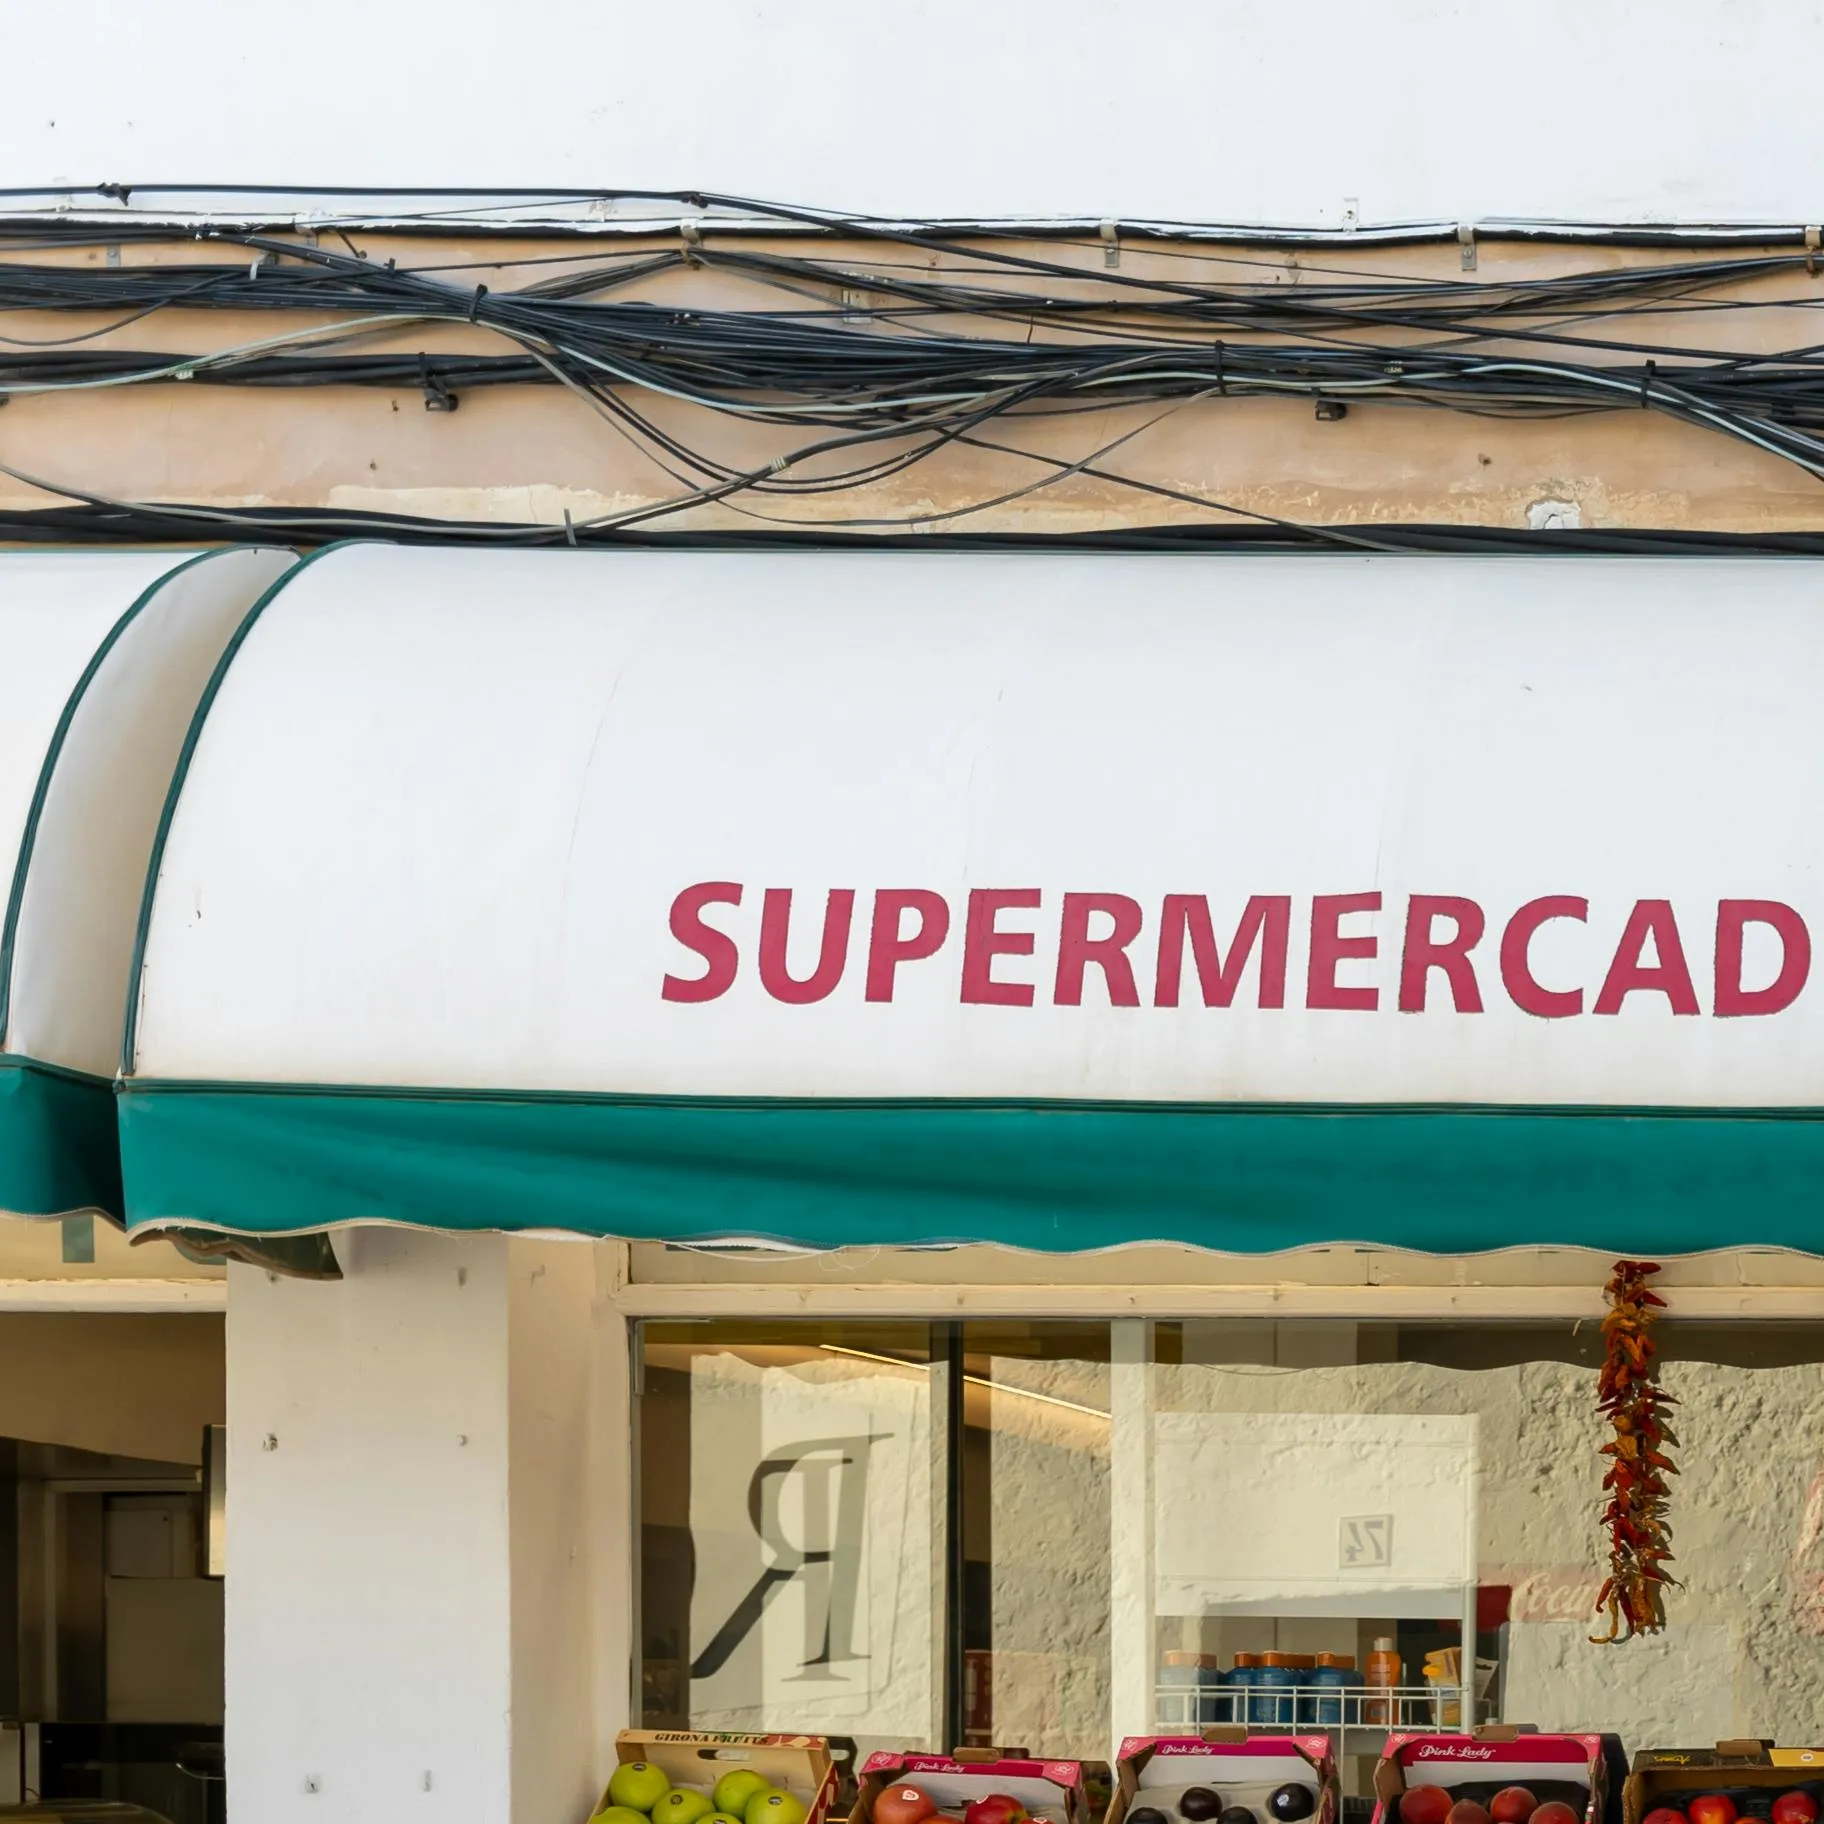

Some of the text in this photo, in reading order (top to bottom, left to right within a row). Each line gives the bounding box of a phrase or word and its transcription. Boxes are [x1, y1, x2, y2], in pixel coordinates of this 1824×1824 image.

[655, 1733, 769, 1745] GIRONA FRUITS
[1419, 1745, 1492, 1759] Pink Lady
